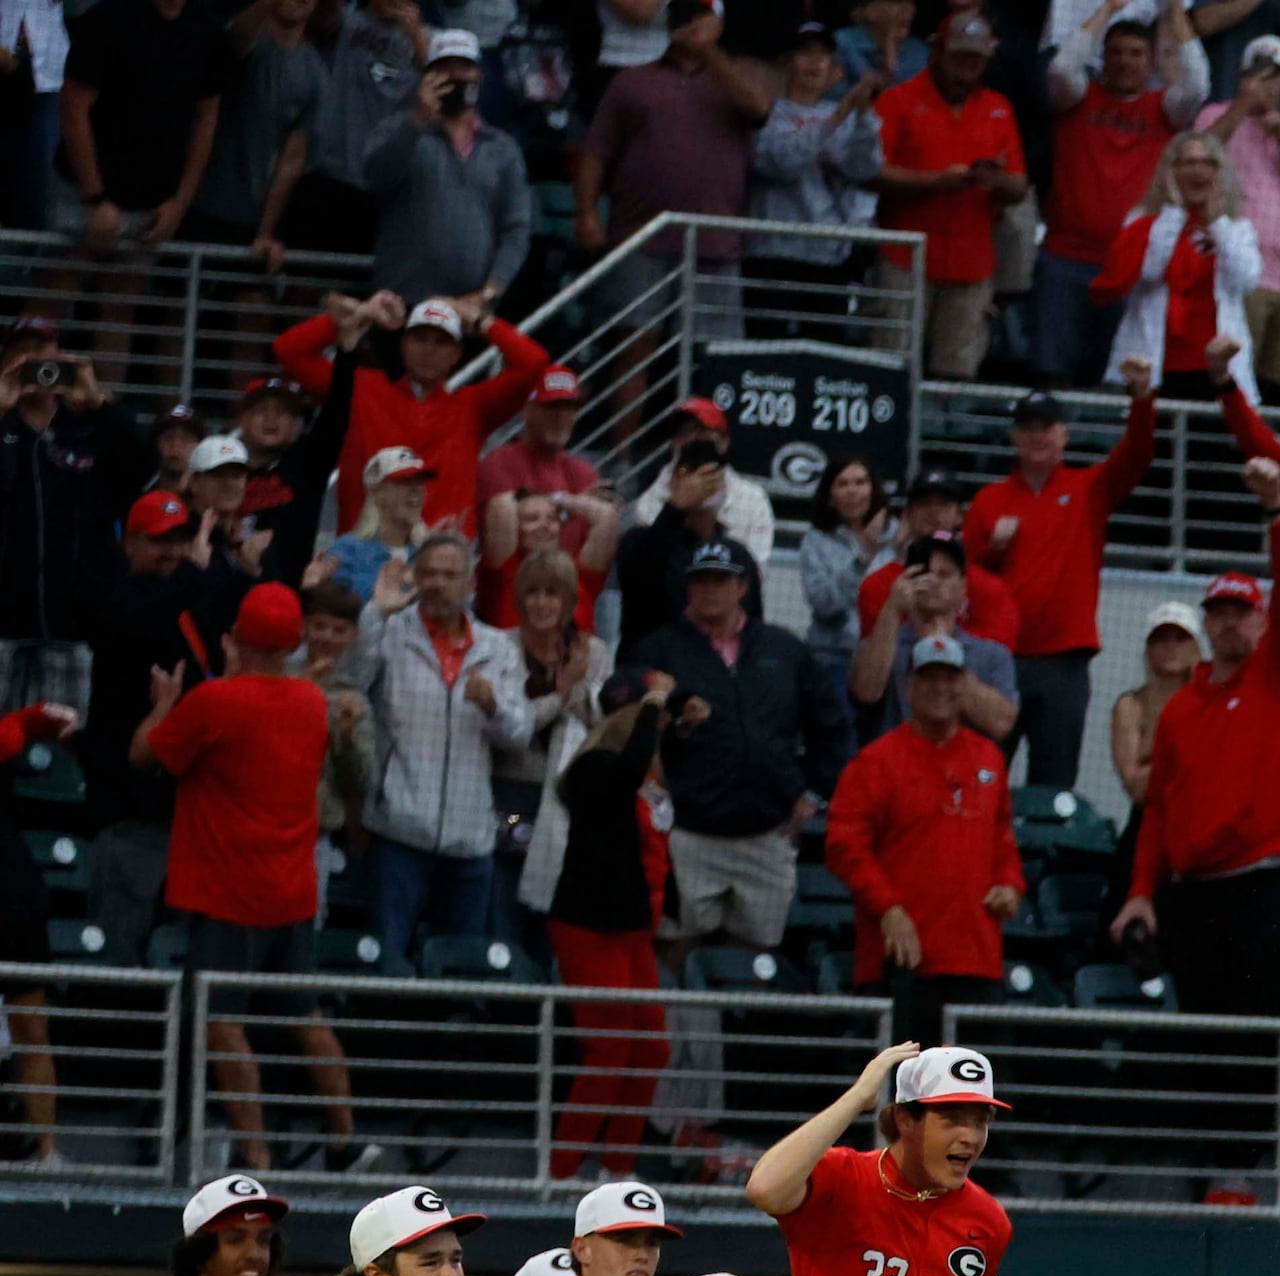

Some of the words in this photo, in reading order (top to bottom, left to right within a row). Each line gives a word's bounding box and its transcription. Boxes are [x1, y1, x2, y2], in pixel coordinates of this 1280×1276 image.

[739, 391, 796, 427] 209
[812, 396, 869, 433] 210
[950, 1059, 986, 1083] G
[228, 1179, 258, 1197] G
[414, 1191, 445, 1213] G
[624, 1190, 657, 1211] G
